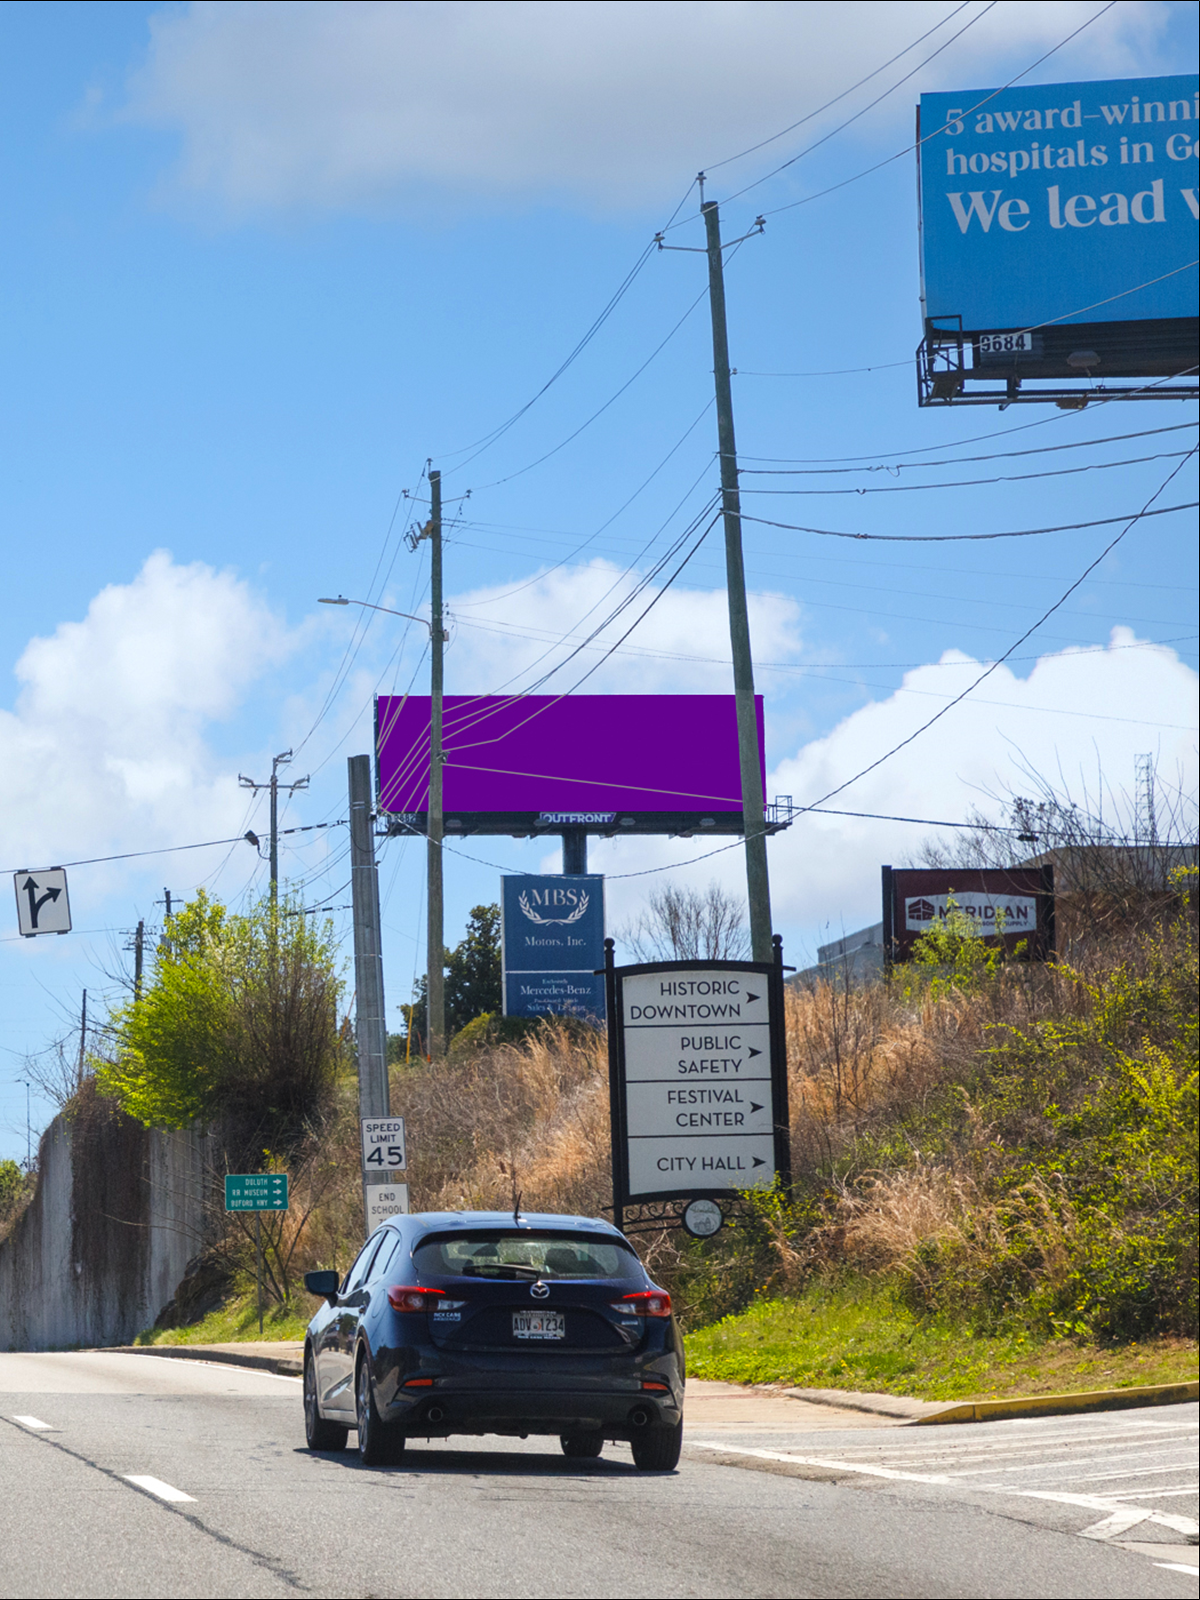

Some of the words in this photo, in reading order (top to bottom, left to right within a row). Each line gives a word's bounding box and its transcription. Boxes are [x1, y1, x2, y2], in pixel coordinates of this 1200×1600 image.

[944, 108, 965, 135] 5
[945, 138, 1109, 178] hospitals
[1119, 136, 1155, 165] in
[945, 189, 1031, 234] We
[1047, 178, 1167, 230] lead
[981, 334, 1026, 351] 9684
[543, 814, 611, 823] OUTFRONT
[531, 888, 579, 906] MBS
[939, 905, 1029, 919] MRIDAN
[567, 936, 587, 946] Inc.
[520, 985, 591, 995] Mercedes-Benz
[660, 980, 740, 996] HISTORIC
[630, 1003, 741, 1020] DOWNTOWN
[680, 1035, 742, 1051] PUBLIC
[678, 1058, 743, 1074] SAFETY
[667, 1089, 744, 1105] FESTIVAL
[366, 1123, 400, 1132] SPEED
[676, 1112, 744, 1127] CENTER
[370, 1134, 397, 1144] LIMIT
[366, 1146, 403, 1166] 45
[656, 1156, 697, 1172] CITY
[701, 1156, 746, 1171] HALL
[245, 1178, 268, 1186] DULUTH
[379, 1192, 396, 1201] END
[371, 1205, 404, 1214] SCHOOL
[514, 1317, 531, 1331] ADV
[541, 1317, 564, 1331] 1234
